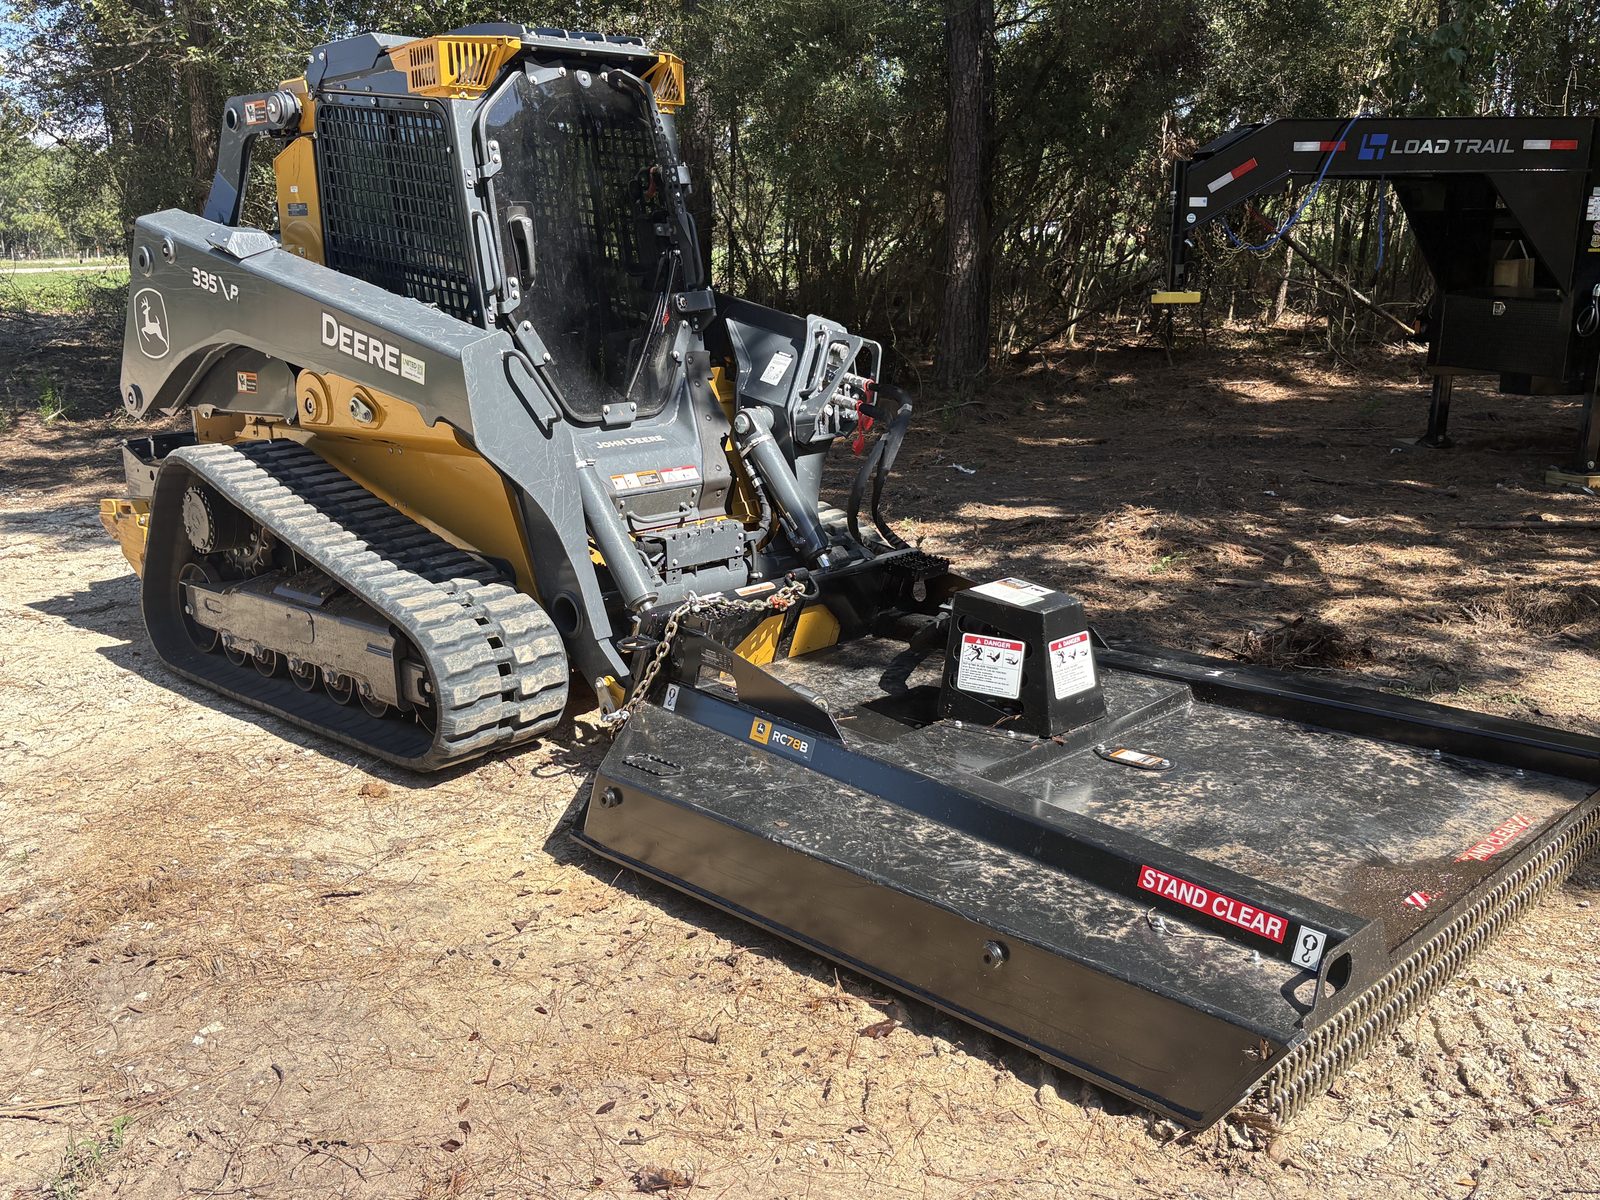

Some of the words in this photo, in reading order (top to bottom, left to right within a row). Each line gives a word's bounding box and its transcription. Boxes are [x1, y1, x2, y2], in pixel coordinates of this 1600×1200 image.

[1390, 139, 1450, 154] LOAD
[1454, 139, 1515, 154] TRAIL
[322, 312, 400, 376] DEERE
[596, 440, 627, 449] JOHN
[624, 435, 666, 445] DEERE
[983, 639, 1011, 649] DANGER
[1062, 635, 1081, 647] DANGER
[772, 731, 809, 753] RC78B
[1142, 869, 1208, 908] STAND
[1212, 896, 1282, 939] CLEAR
